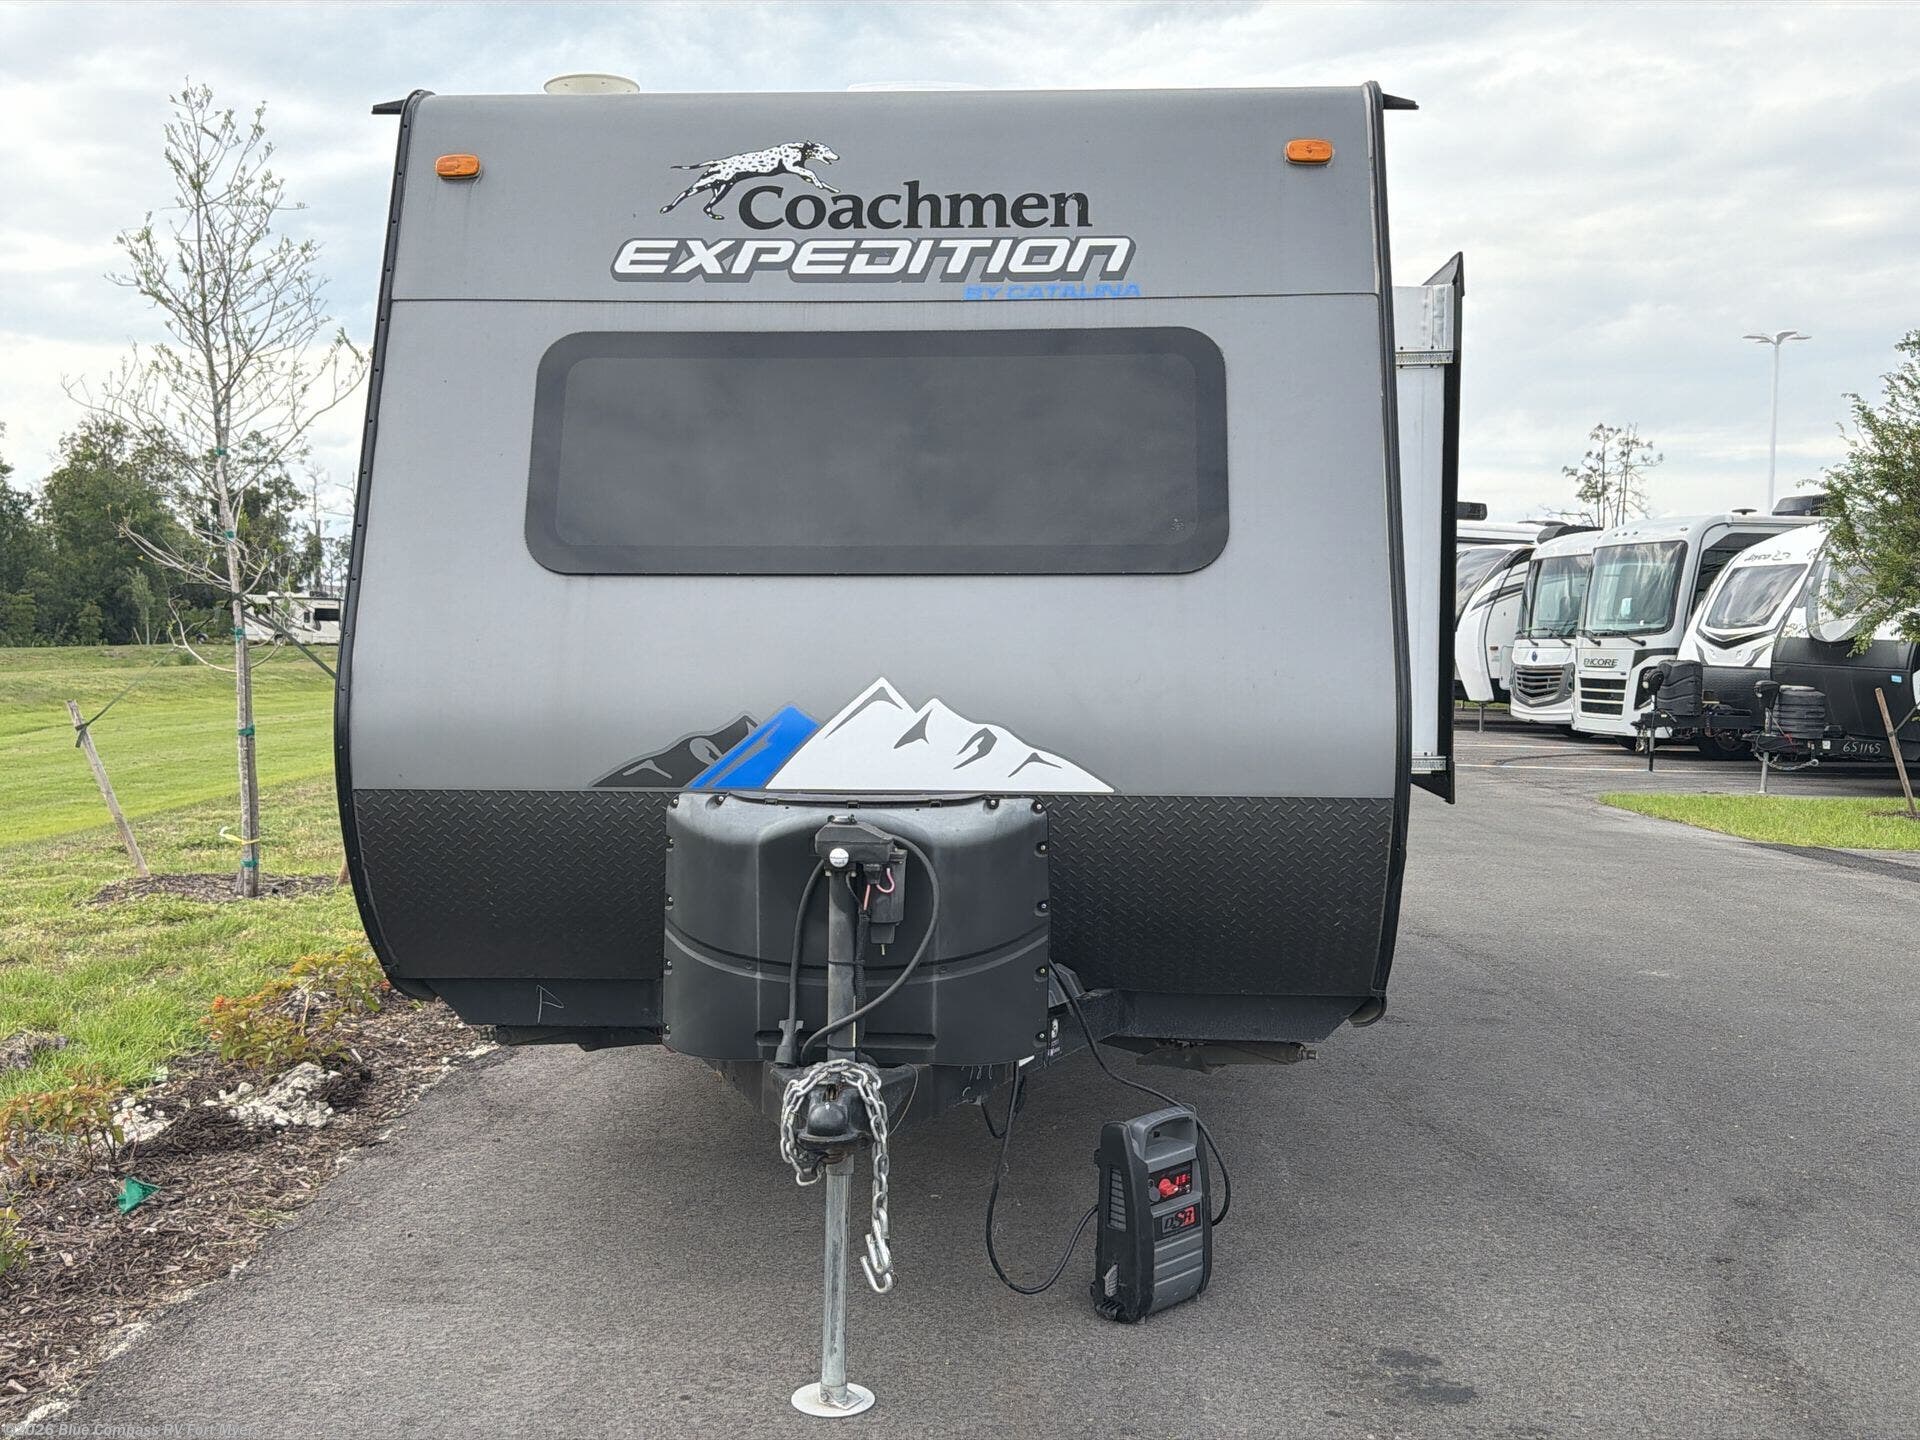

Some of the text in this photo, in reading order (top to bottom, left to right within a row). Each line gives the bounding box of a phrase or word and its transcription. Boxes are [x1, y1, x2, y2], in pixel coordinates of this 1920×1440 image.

[738, 180, 1093, 230] Coachmen
[612, 237, 1134, 279] EXPEDITION
[965, 282, 1141, 300] BY CATALINA
[1584, 658, 1618, 667] ENCORE
